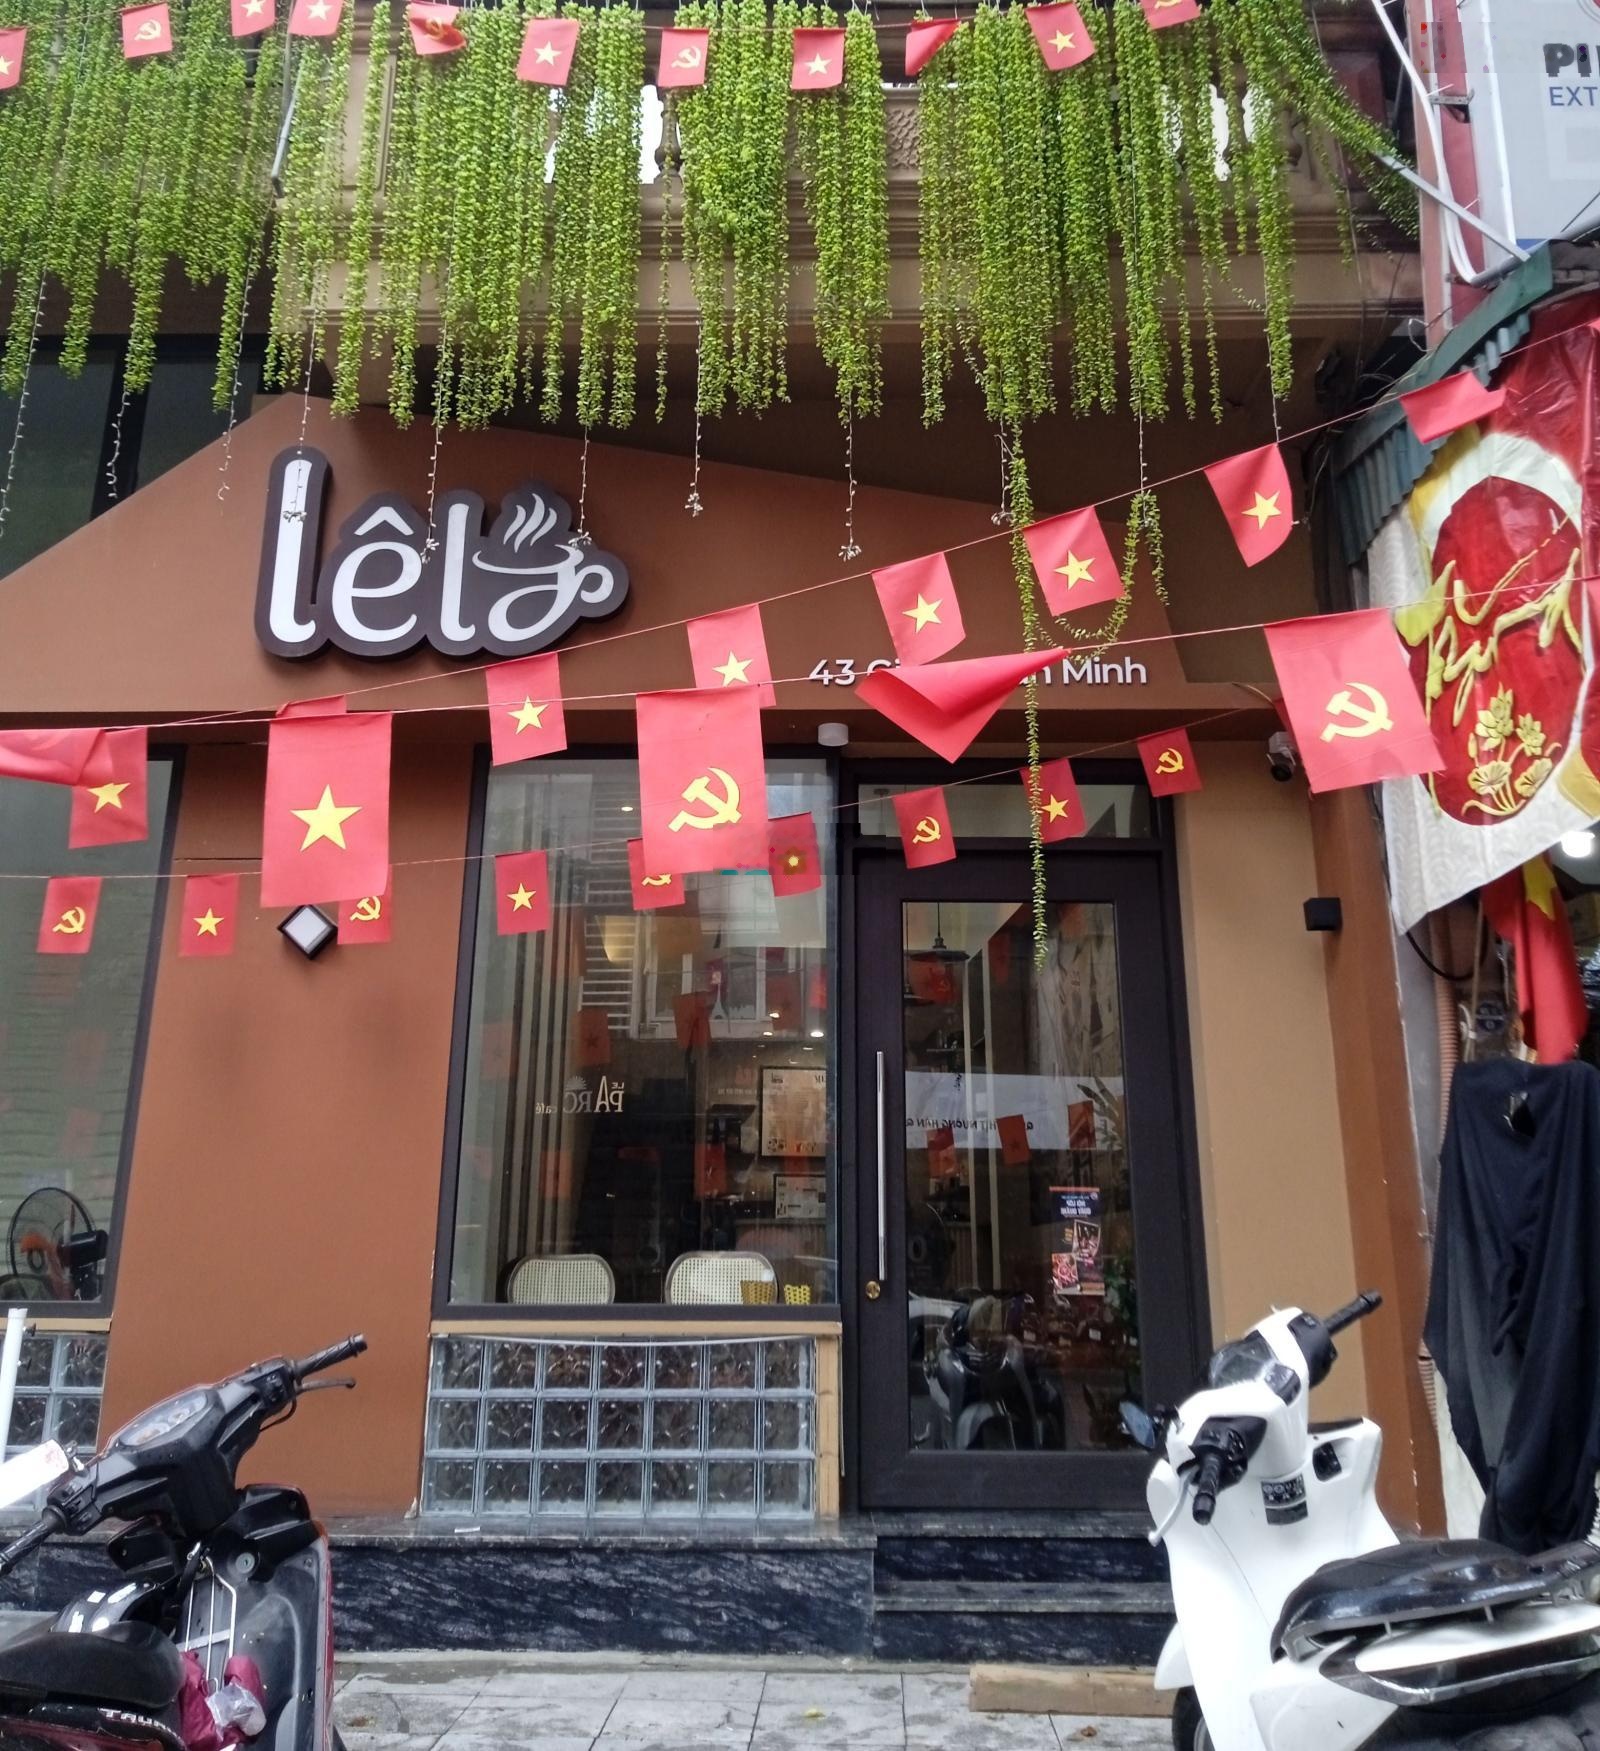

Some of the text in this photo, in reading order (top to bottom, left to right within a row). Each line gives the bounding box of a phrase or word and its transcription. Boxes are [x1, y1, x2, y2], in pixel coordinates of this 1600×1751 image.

[1543, 43, 1600, 77] PI
[808, 658, 856, 686] 43
[1062, 656, 1147, 685] Minh
